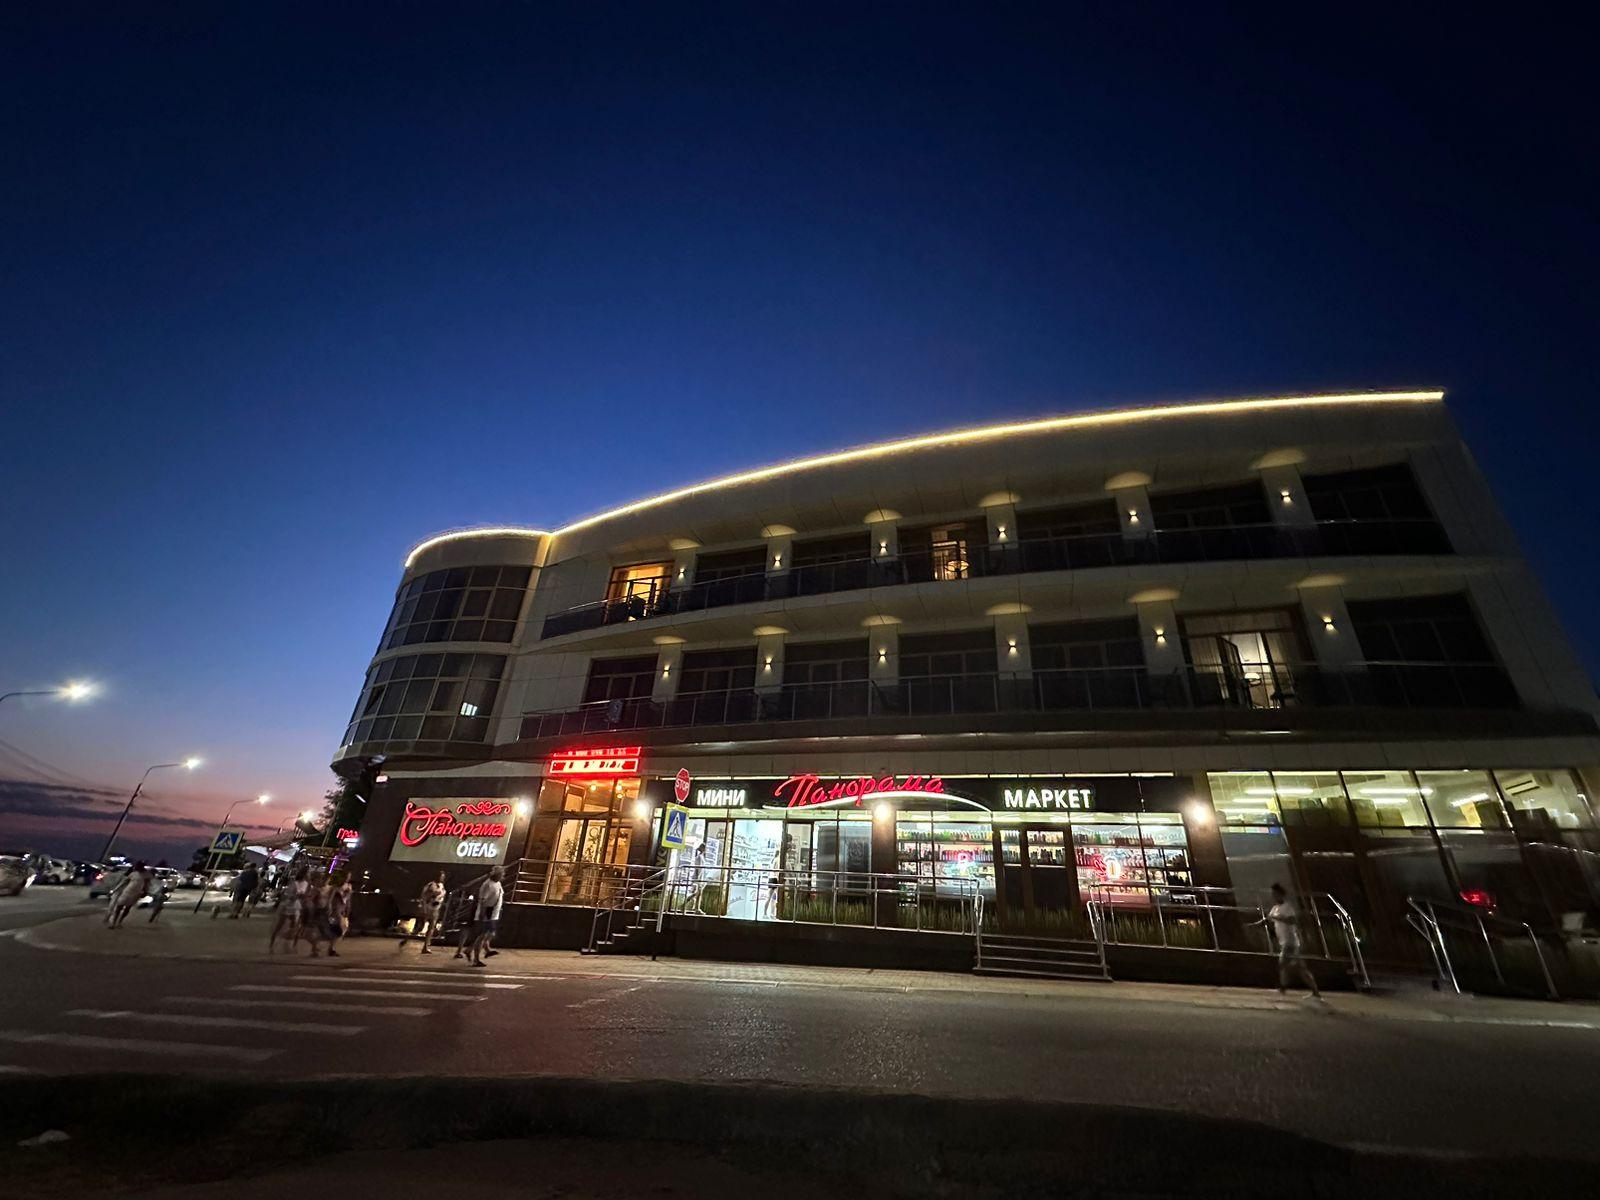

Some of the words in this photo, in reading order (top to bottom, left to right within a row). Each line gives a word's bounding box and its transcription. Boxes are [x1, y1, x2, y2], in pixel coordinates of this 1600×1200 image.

[675, 779, 690, 791] STOP
[697, 789, 746, 807] МИНИ
[775, 774, 945, 807] Панорама
[1004, 788, 1093, 809] МАРКЕТ
[400, 802, 507, 848] Панорама
[456, 841, 498, 858] ОТЕЛЬ
